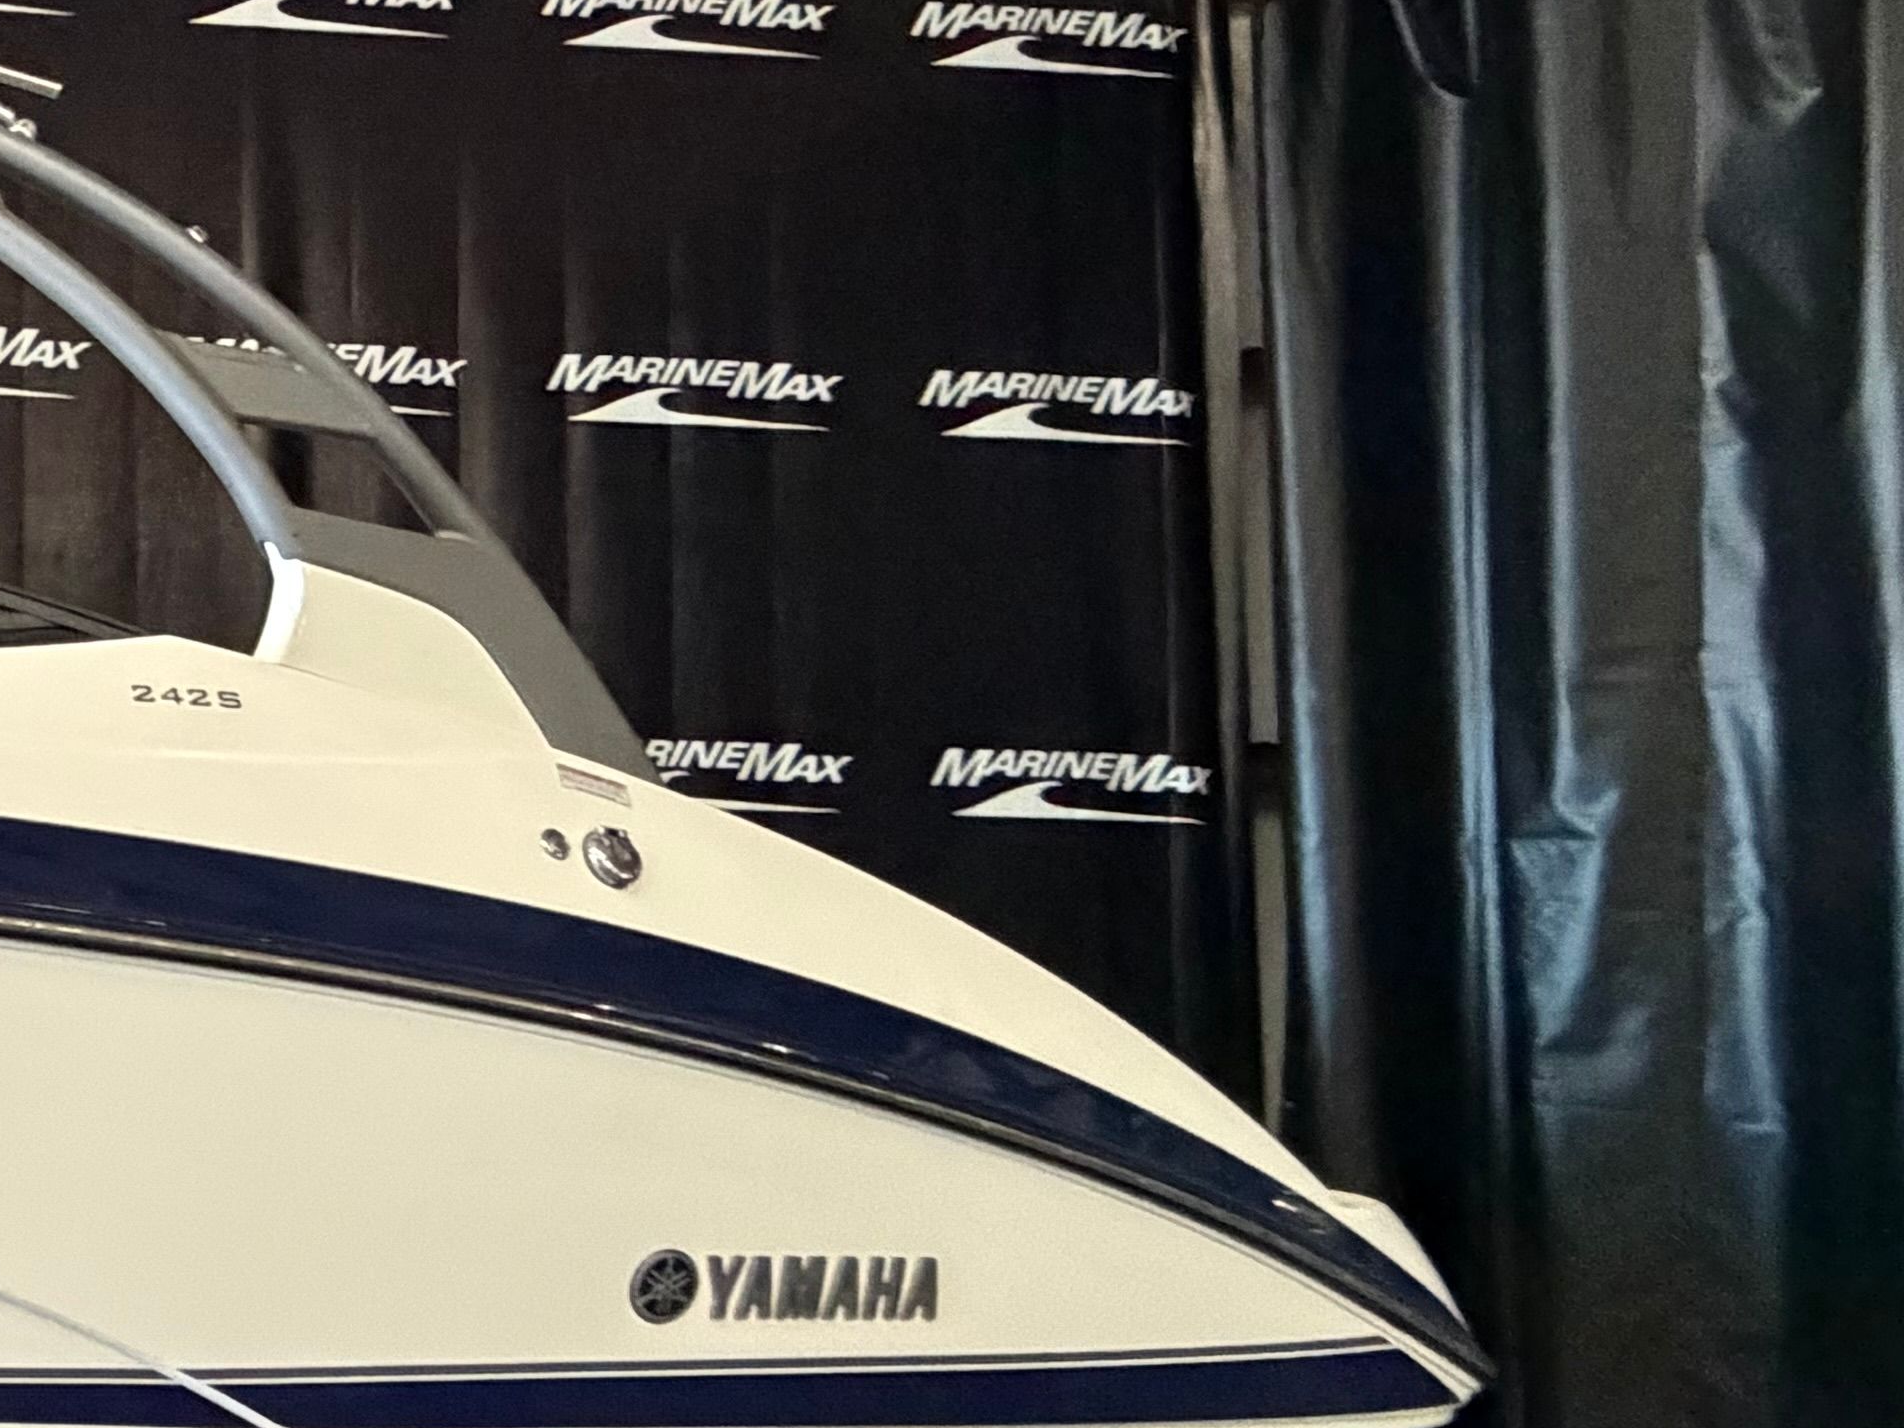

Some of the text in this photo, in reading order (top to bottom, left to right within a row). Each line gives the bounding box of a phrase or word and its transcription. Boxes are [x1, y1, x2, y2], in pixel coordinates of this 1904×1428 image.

[911, 2, 1186, 49] MARINEMAX
[547, 354, 842, 401] MARINEMAX
[130, 684, 243, 710] 242S
[707, 1254, 939, 1322] YAMAHA
